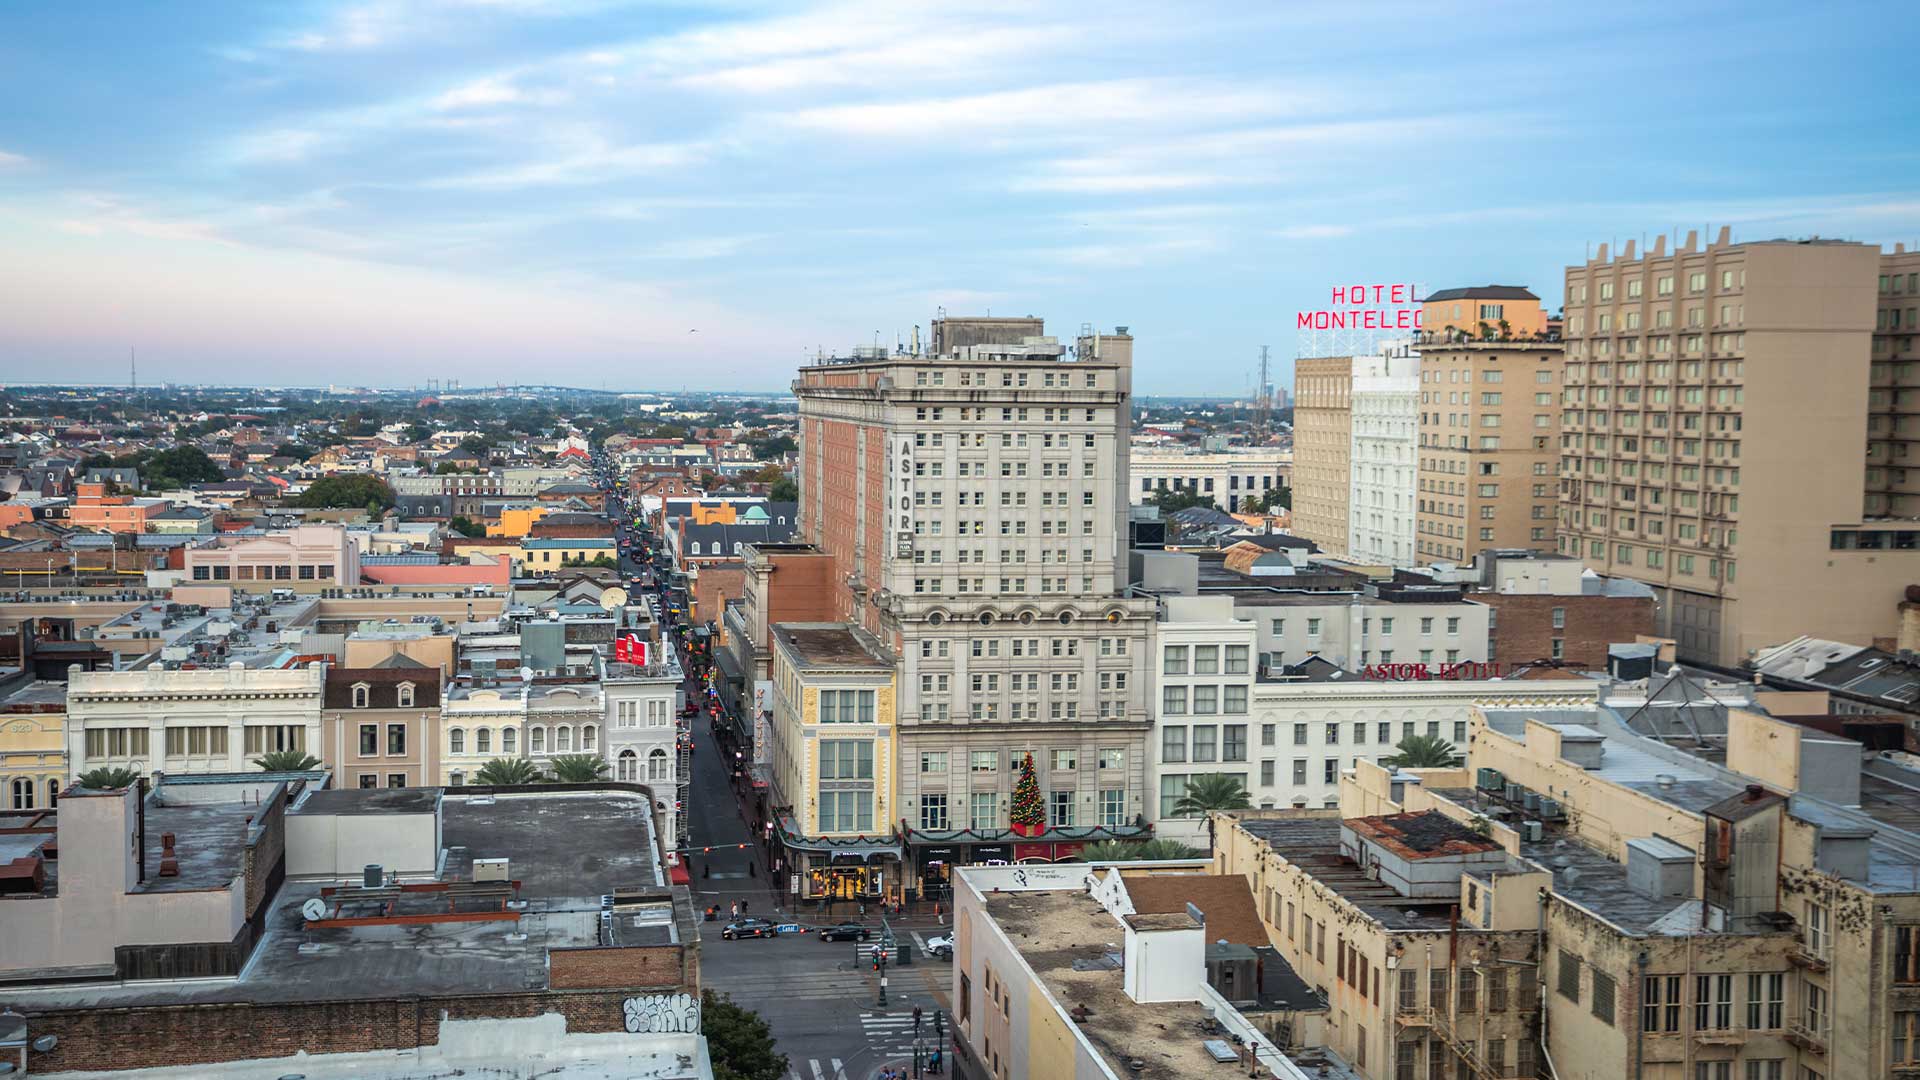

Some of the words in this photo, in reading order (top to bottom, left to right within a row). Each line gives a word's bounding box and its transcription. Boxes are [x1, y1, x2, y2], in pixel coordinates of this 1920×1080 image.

[1332, 284, 1423, 304] HOTEL
[902, 441, 910, 528] ASTOR
[1361, 663, 1428, 679] ASTOR
[1439, 663, 1506, 679] HOTEL
